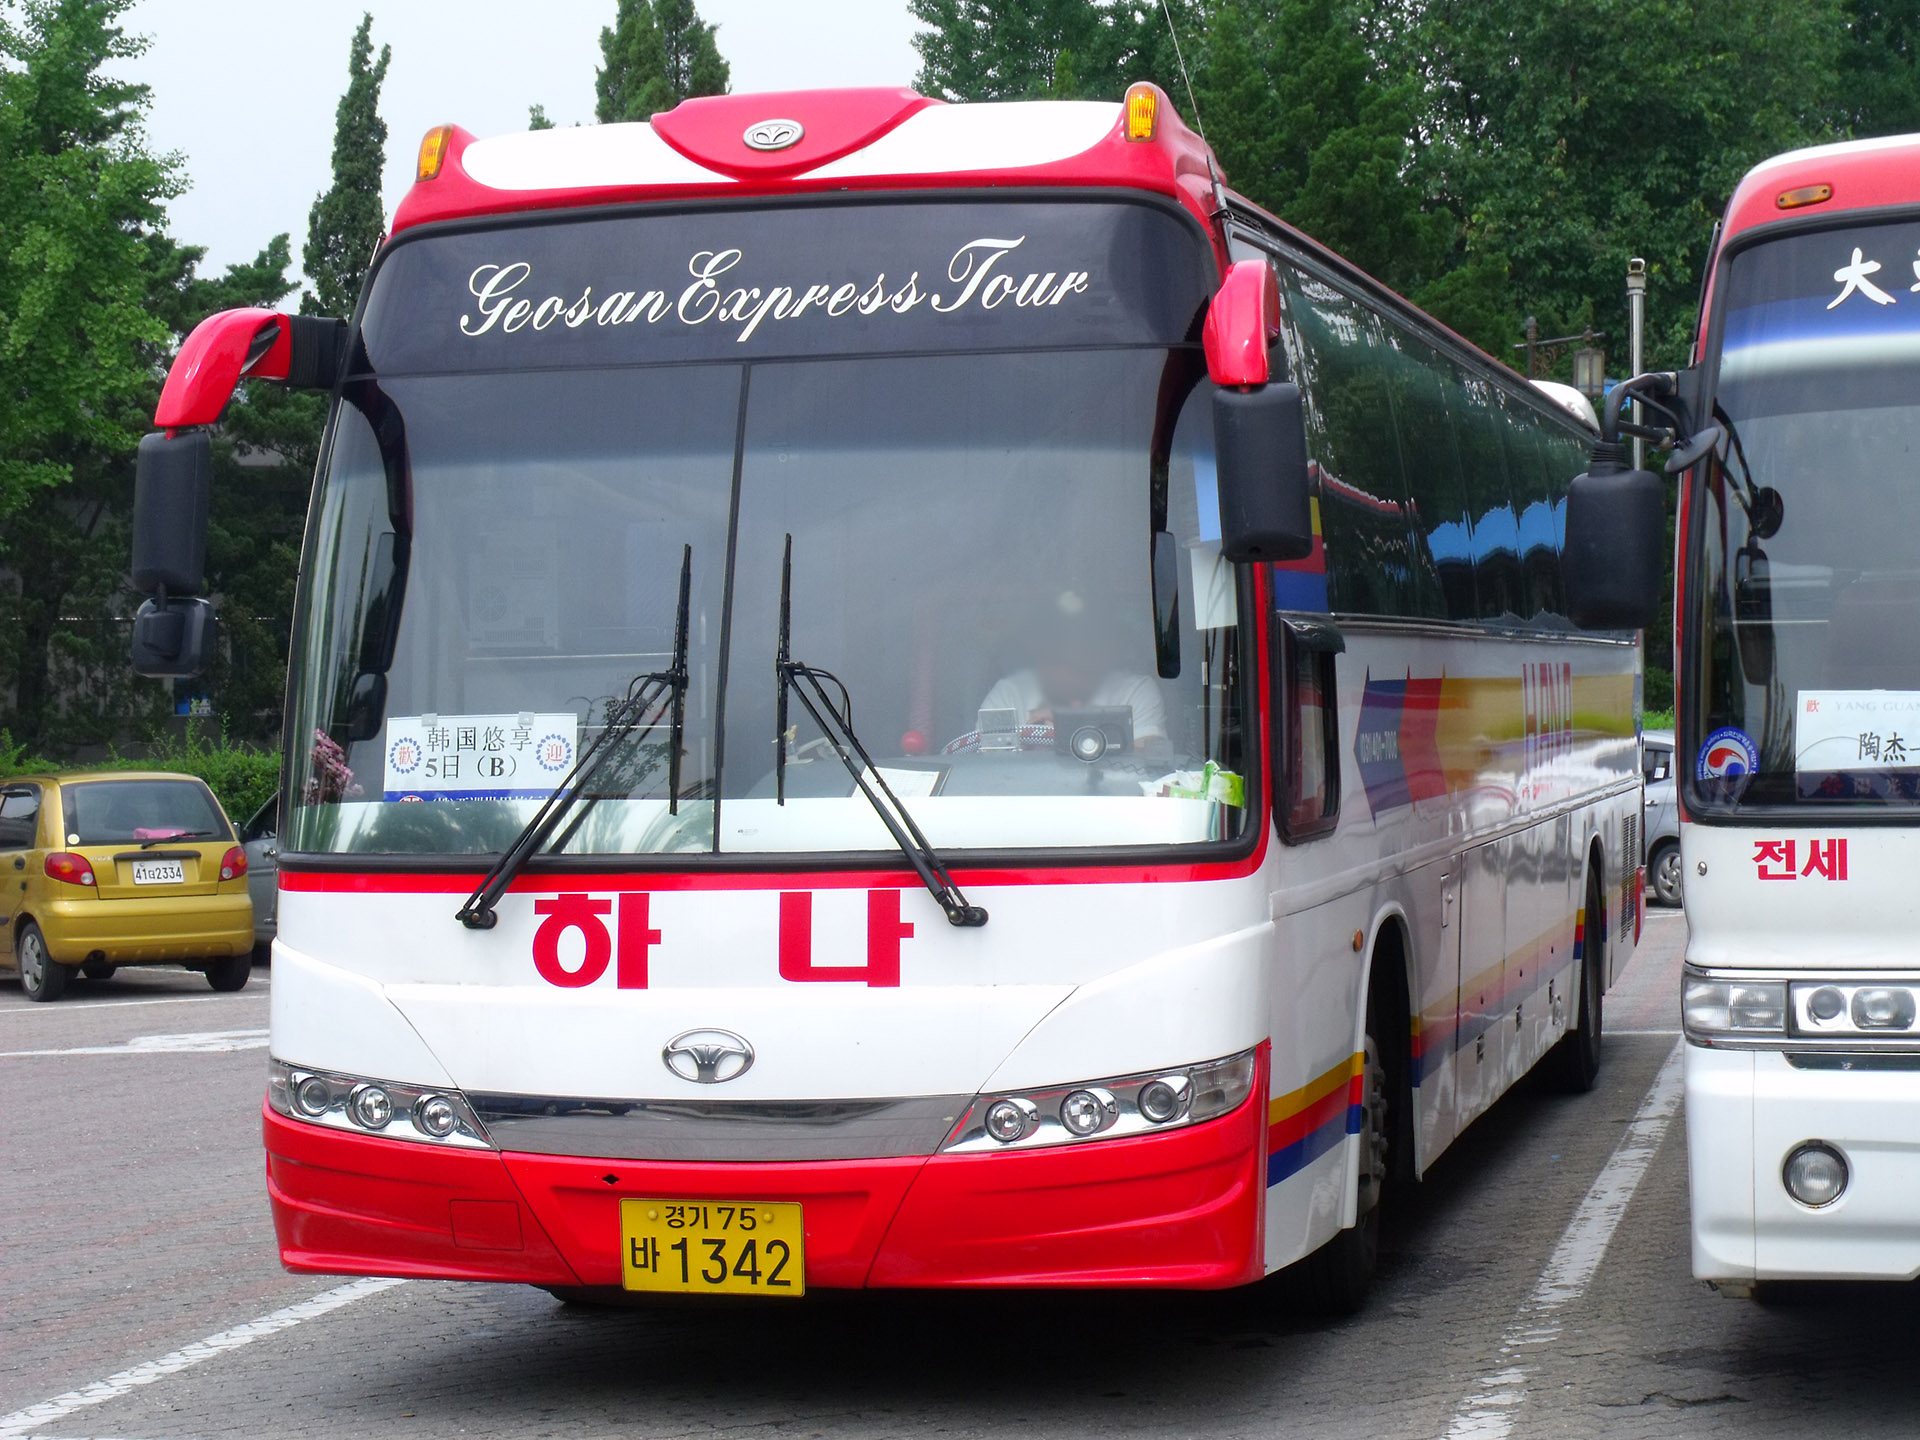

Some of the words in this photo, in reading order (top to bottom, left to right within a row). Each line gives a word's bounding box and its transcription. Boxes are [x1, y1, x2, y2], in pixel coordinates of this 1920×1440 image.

[459, 261, 671, 337] Geosan
[676, 248, 926, 343] Express
[931, 235, 1088, 313] Tour
[1826, 247, 1920, 310] 大
[1835, 701, 1877, 712] YANG
[426, 725, 533, 753] 韩国悠享
[545, 743, 563, 763] 迎
[1752, 838, 1848, 881] 전세
